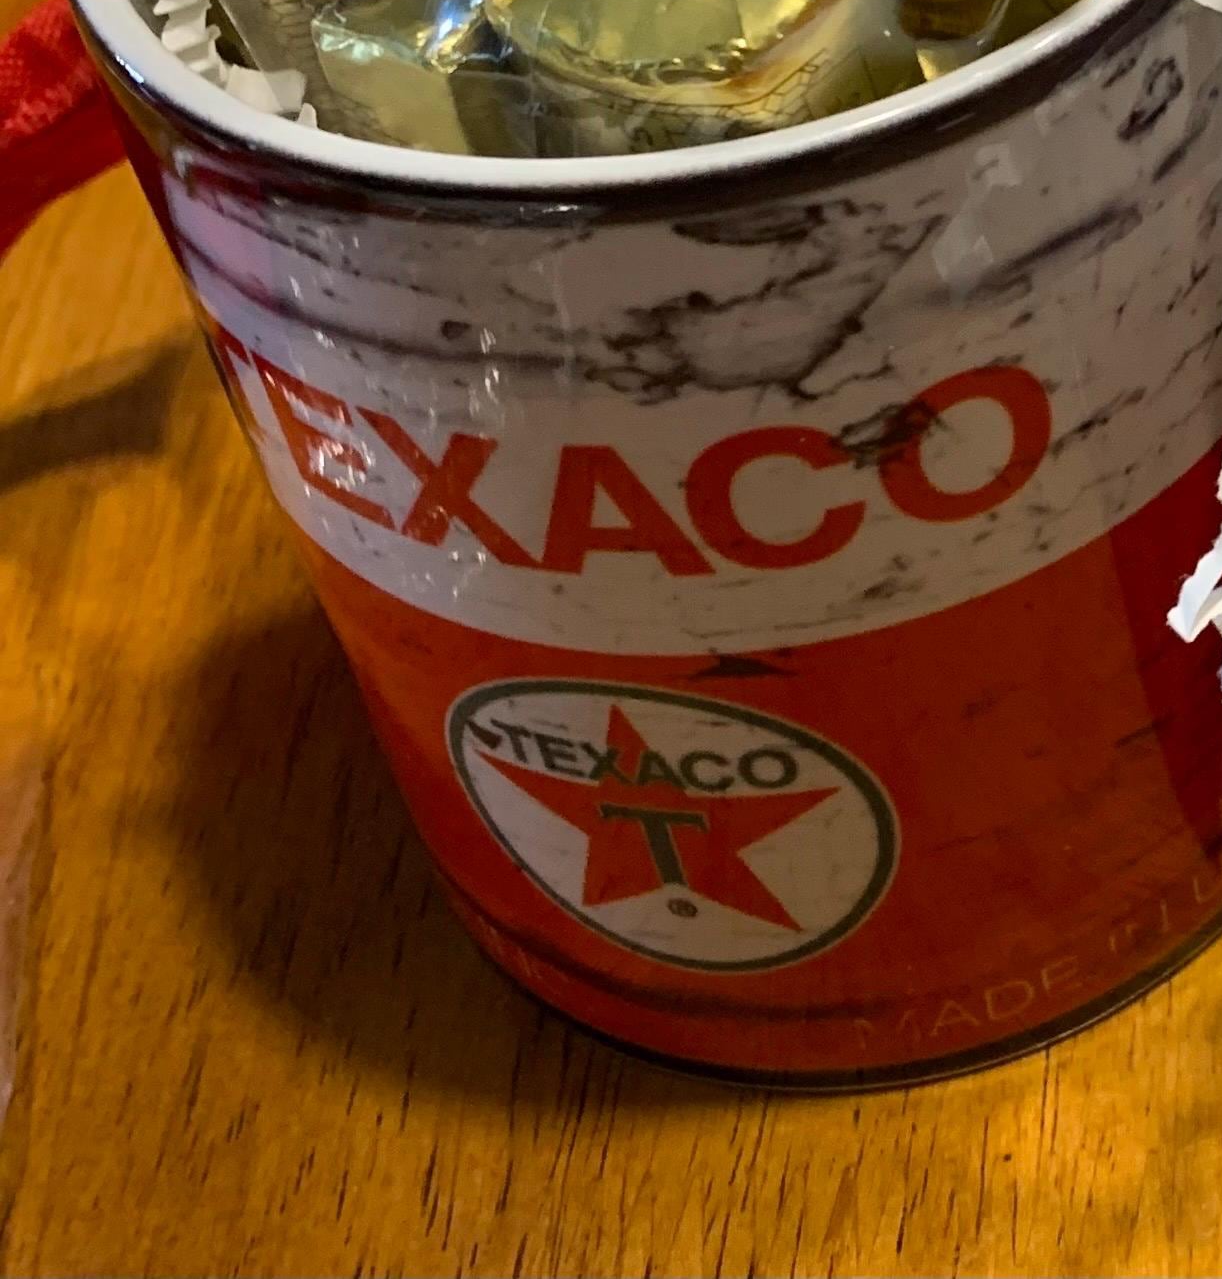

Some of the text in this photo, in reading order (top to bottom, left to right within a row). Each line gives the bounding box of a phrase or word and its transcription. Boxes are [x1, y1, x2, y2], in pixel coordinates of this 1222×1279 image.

[213, 323, 1052, 578] TEXACO
[490, 719, 798, 793] TEXACO
[600, 802, 711, 886] T
